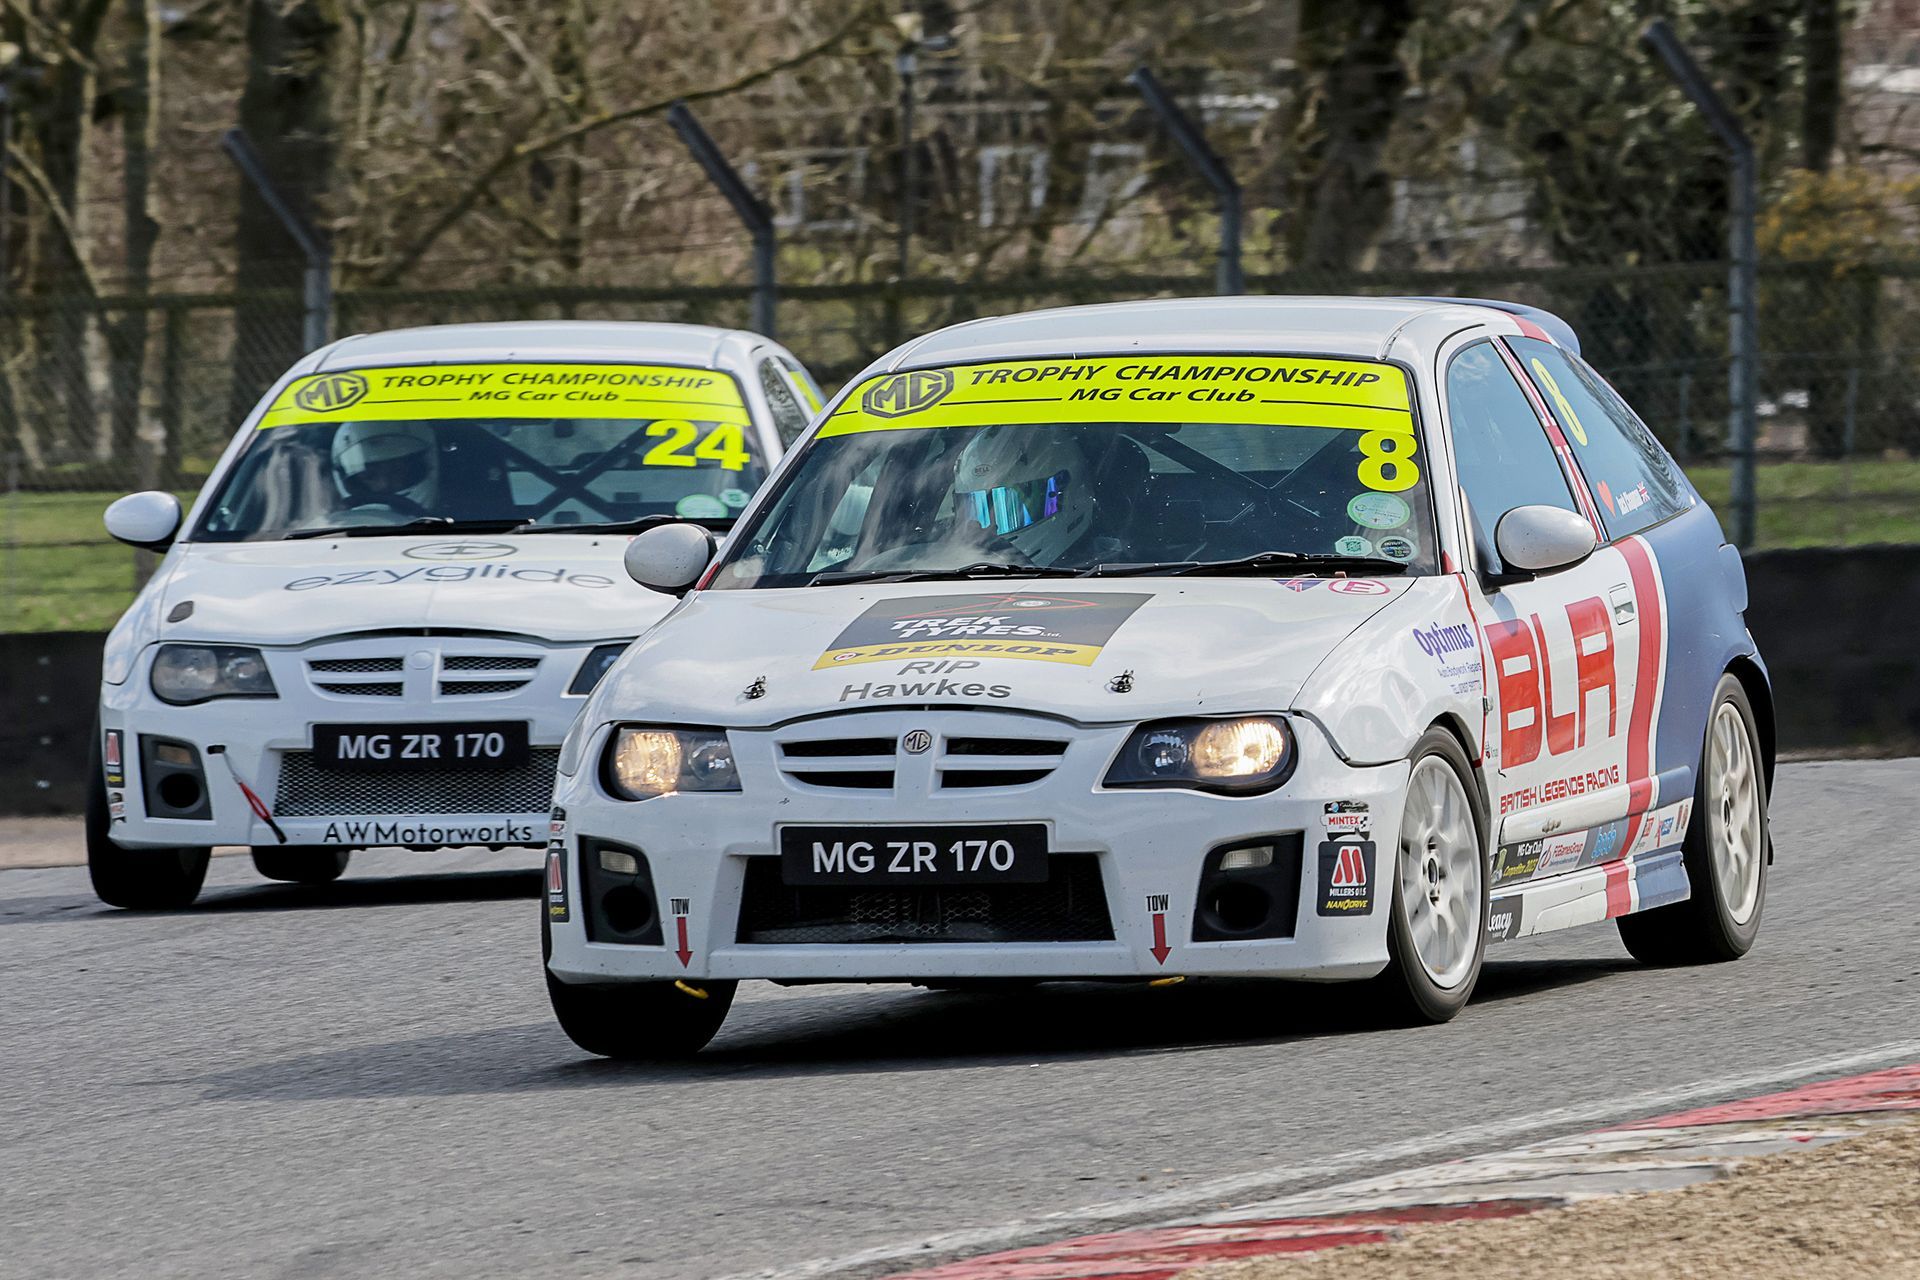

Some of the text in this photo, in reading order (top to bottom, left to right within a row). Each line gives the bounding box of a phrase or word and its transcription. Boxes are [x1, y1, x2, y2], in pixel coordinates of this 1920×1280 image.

[383, 372, 713, 389] TROPHY CHAMPIONSHIP
[971, 365, 1380, 387] TROPHY CHAMPIONSHIP
[303, 375, 362, 408] MG
[468, 391, 619, 401] MG Car Club
[873, 371, 944, 411] MG
[1069, 388, 1255, 402] MG Car Club
[1531, 358, 1588, 447] 8
[642, 419, 751, 472] 24
[1357, 430, 1420, 492] 8
[285, 564, 615, 591] ezyglide
[1343, 581, 1375, 593] E
[890, 616, 1011, 629] TREK
[898, 625, 1046, 638] TYRES
[868, 643, 1078, 656] DUNLOP
[1412, 621, 1475, 664] Optimus
[897, 660, 981, 676] RIP
[839, 678, 1012, 702] Hawkes
[1483, 595, 1617, 770] BLA
[337, 732, 504, 759] MG ZR 170
[1500, 764, 1620, 814] BRITISH LEGENDS RACING
[323, 819, 533, 843] AWMotorworks
[1328, 816, 1361, 825] MINTEX
[812, 839, 1015, 873] MG ZR 170
[1146, 894, 1169, 912] TOW
[1329, 888, 1355, 897] MILLERS
[670, 897, 690, 914] TOW
[1326, 899, 1369, 910] NANODRIVE
[1488, 902, 1513, 938] Leacy
